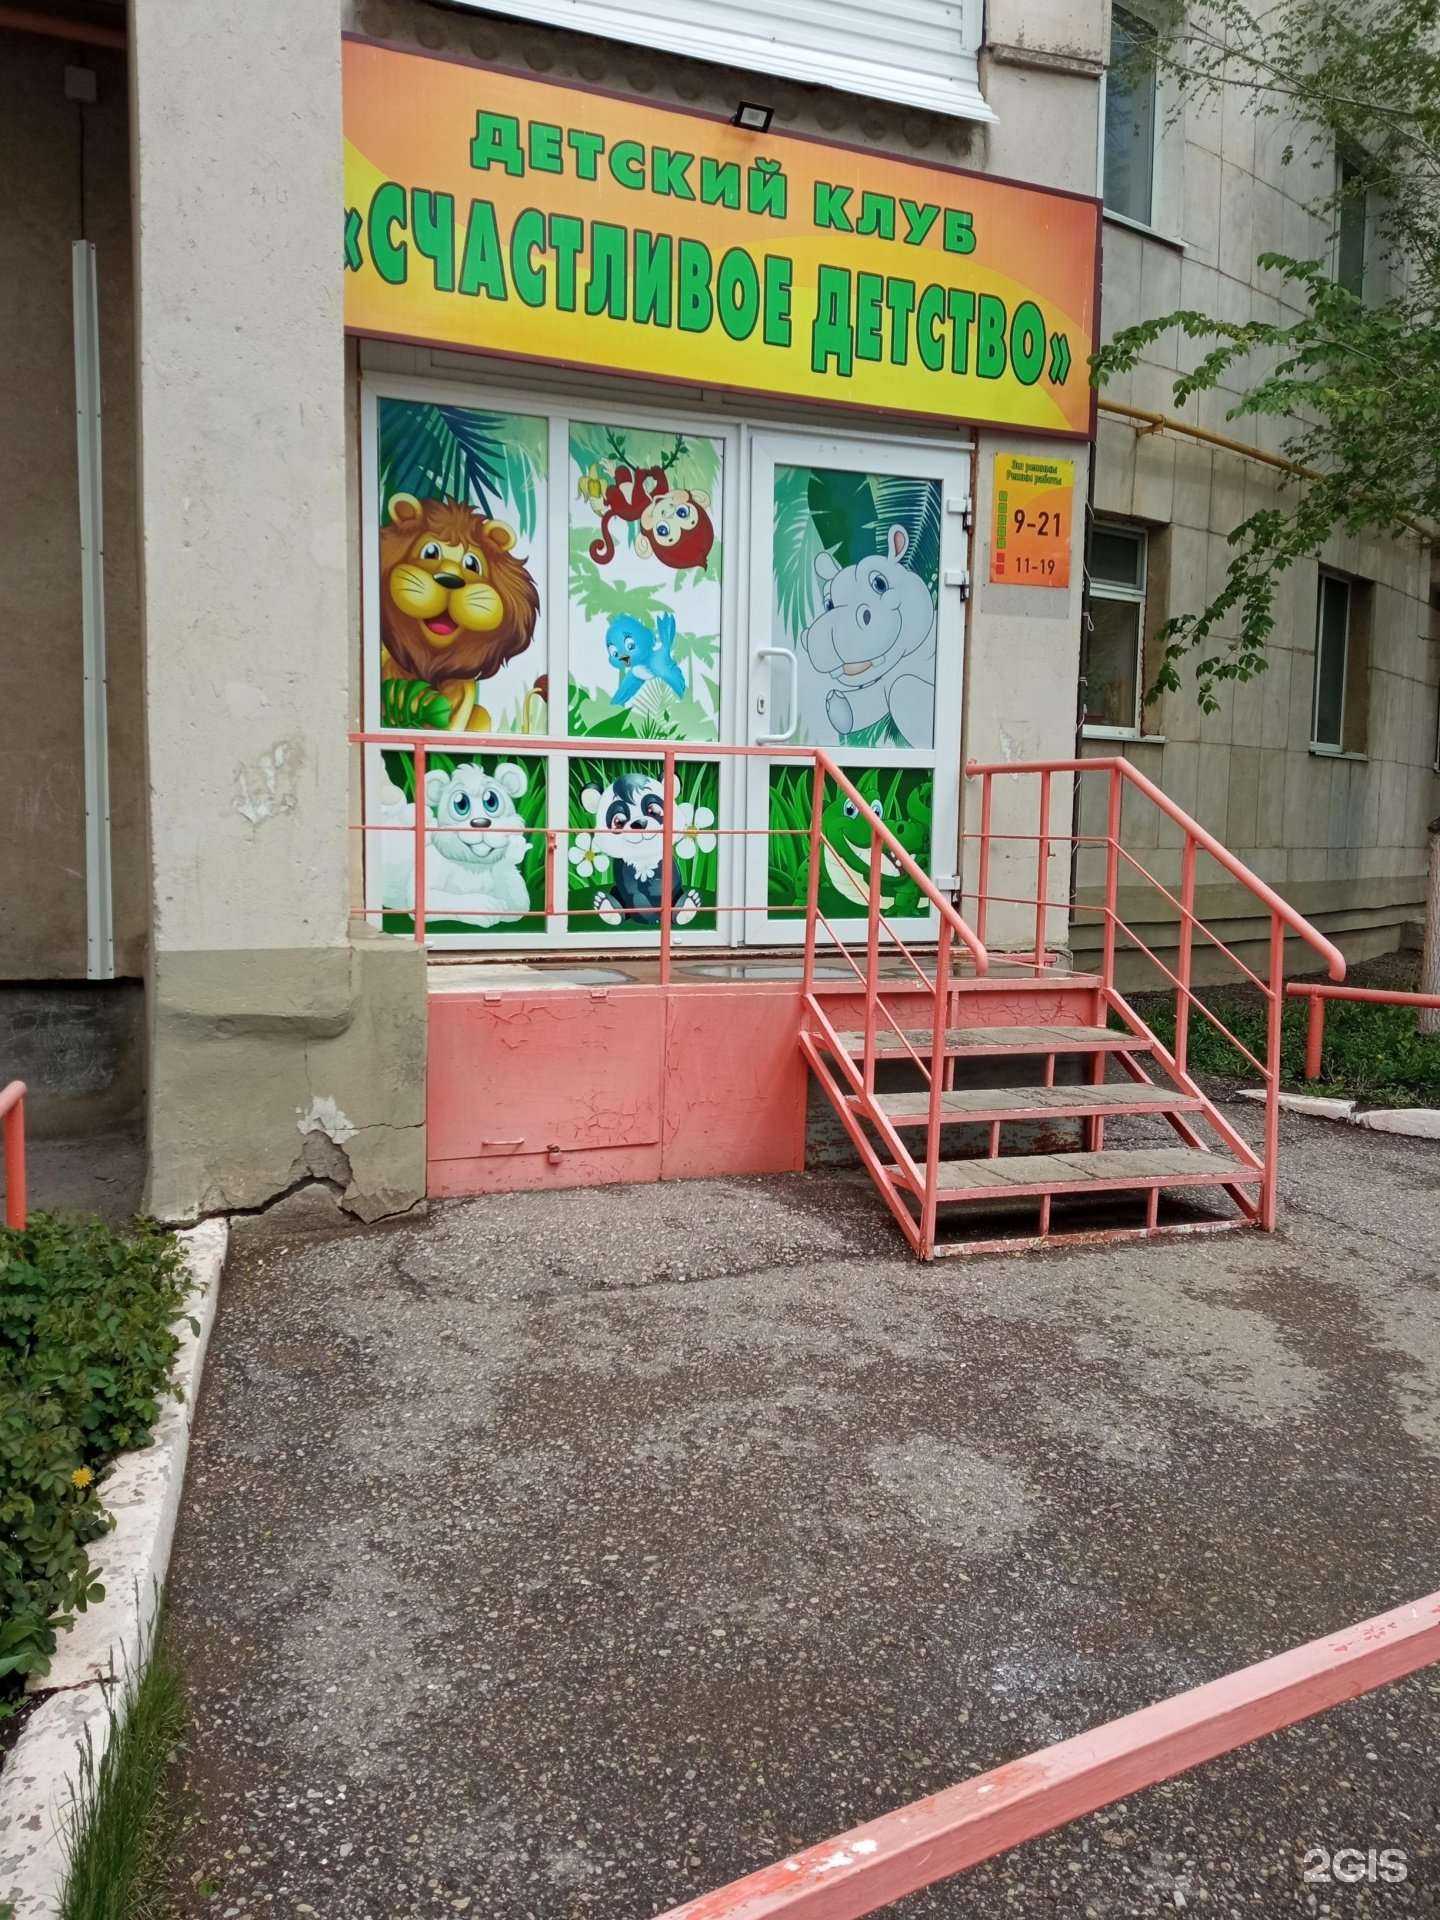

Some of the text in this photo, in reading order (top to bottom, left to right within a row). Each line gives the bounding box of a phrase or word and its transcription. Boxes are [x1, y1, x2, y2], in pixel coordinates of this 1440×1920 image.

[470, 109, 976, 254] ДЕТСКИЙ КЛУБ
[811, 264, 1071, 385] ДЕТСТВО»
[1014, 509, 1061, 537] 9-21
[1016, 556, 1055, 575] 11-19
